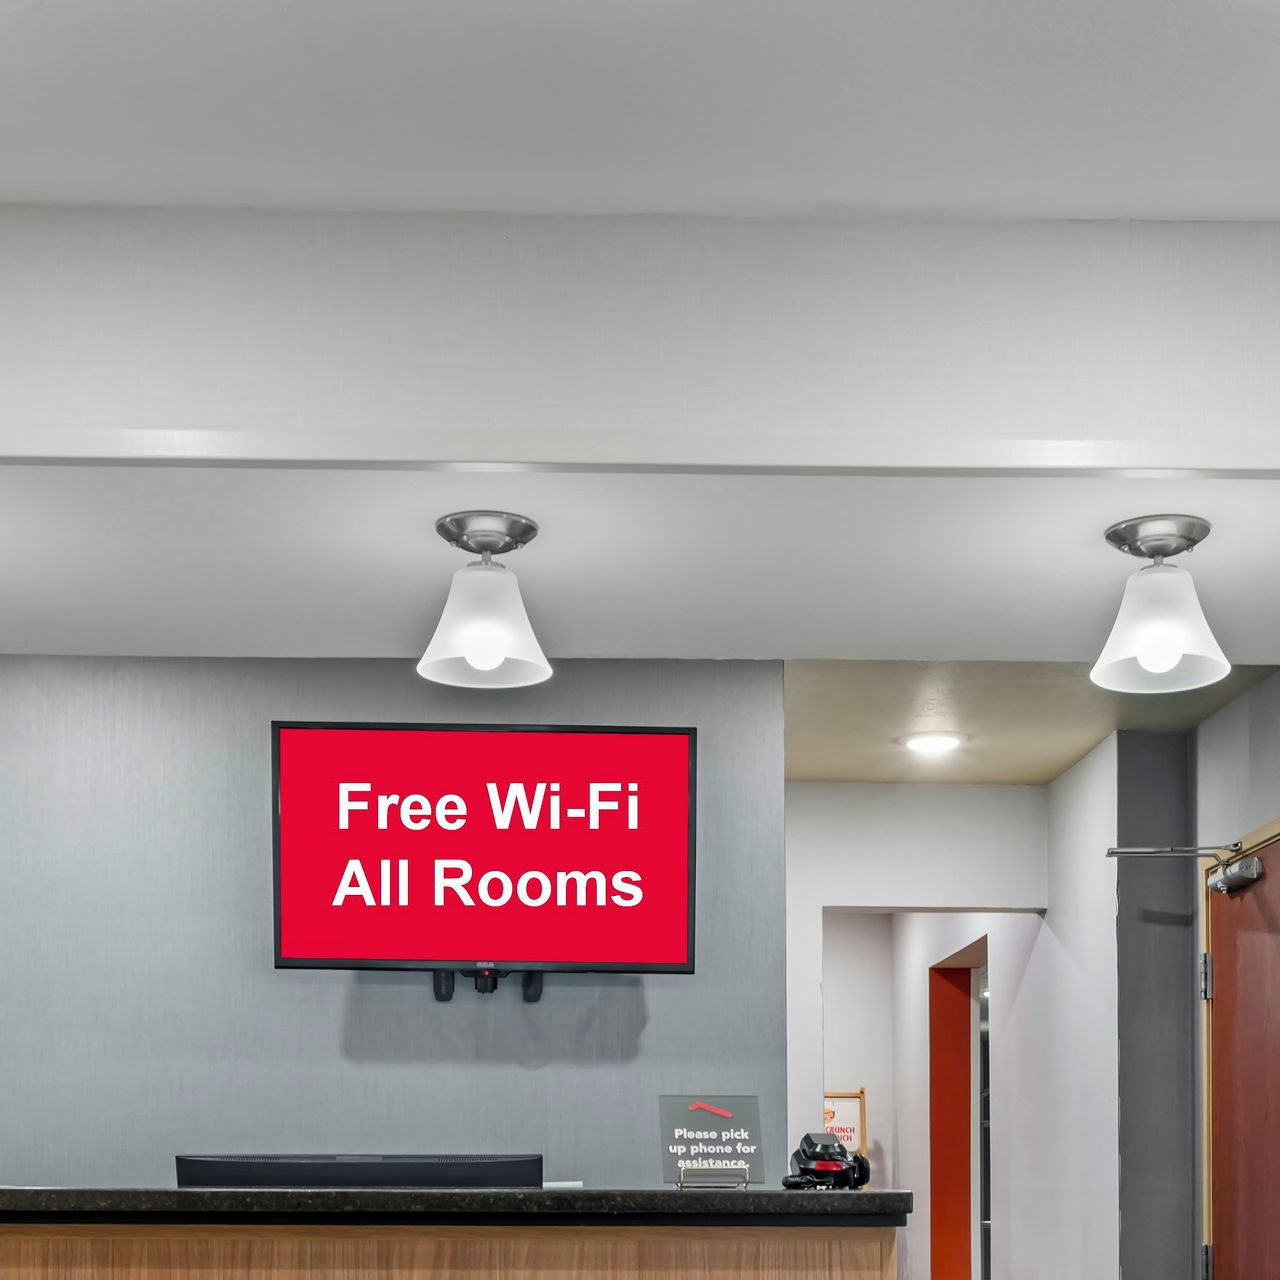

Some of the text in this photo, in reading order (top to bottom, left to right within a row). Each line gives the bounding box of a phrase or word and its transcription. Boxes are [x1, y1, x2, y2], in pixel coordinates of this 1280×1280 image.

[338, 782, 639, 831] Free Wi-Fi
[331, 858, 643, 907] All Rooms
[674, 1128, 750, 1141] Please pick
[825, 1126, 856, 1134] CRUNCH
[668, 1142, 757, 1156] up phone for
[677, 1157, 751, 1168] assistance.
